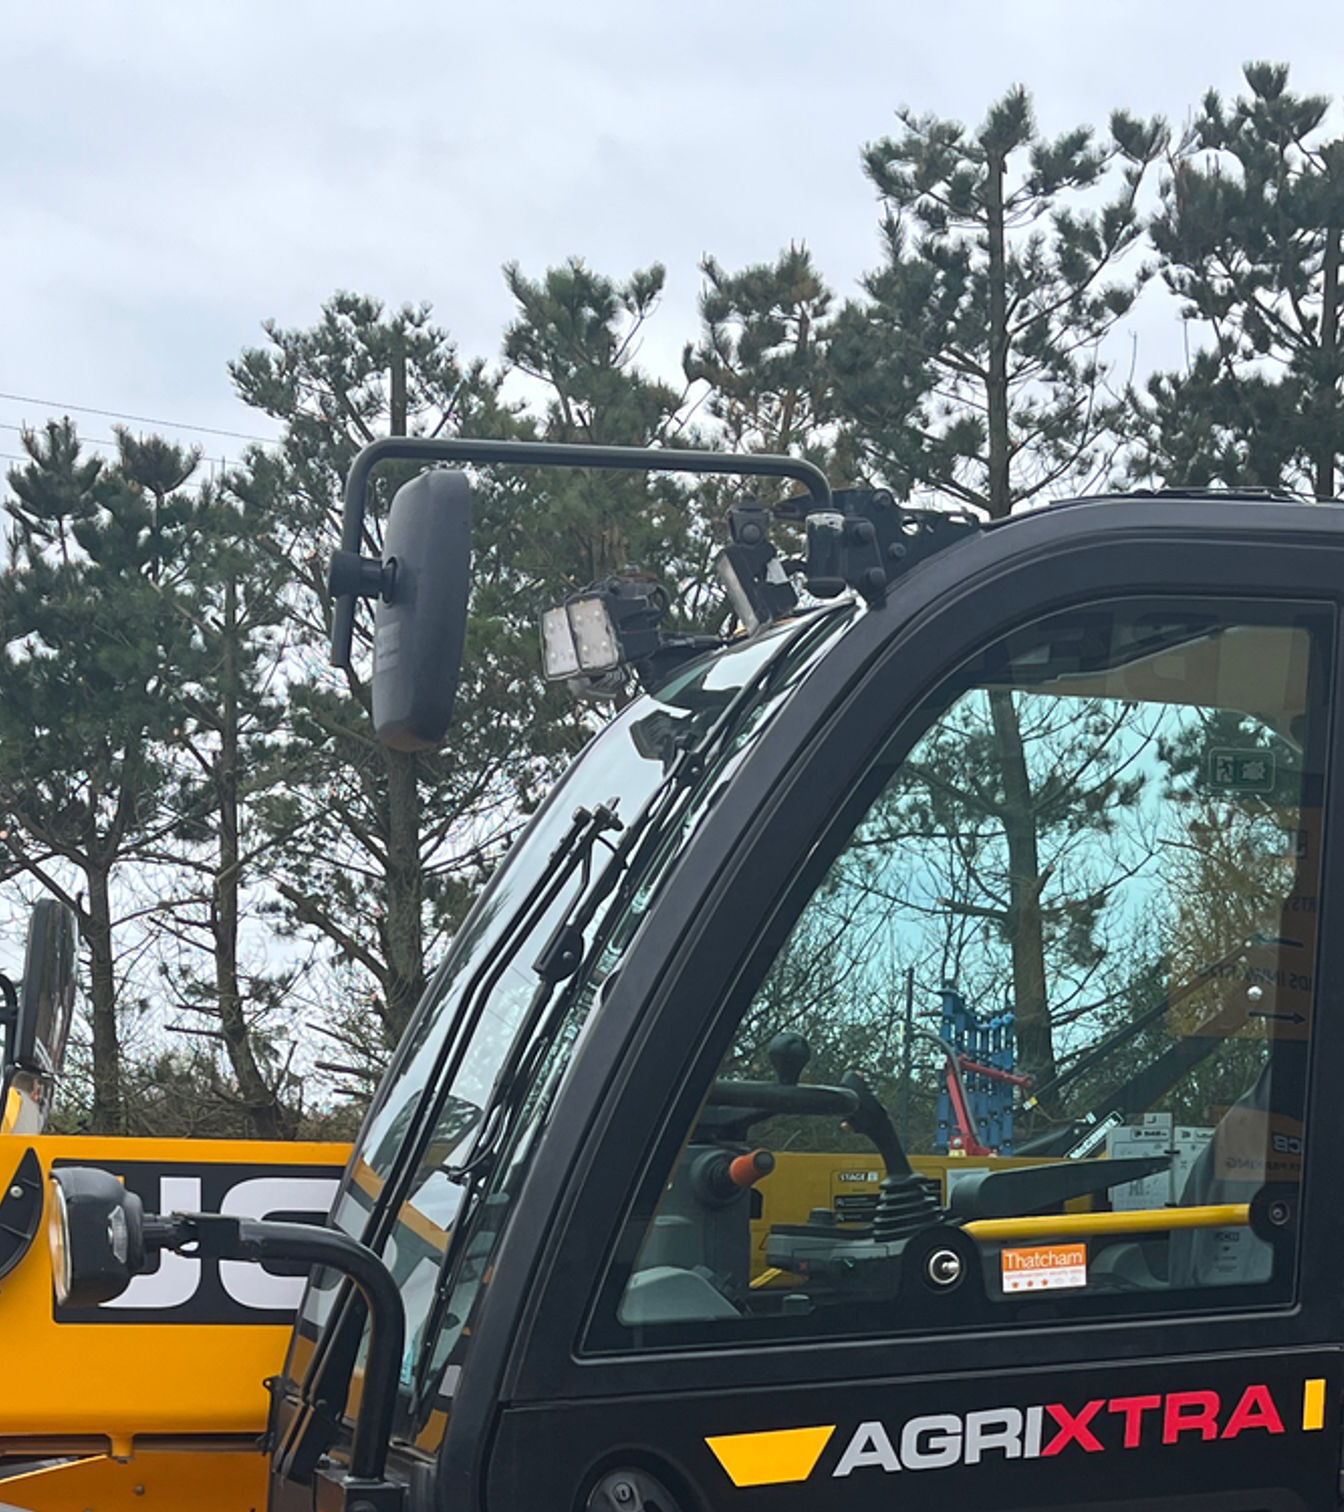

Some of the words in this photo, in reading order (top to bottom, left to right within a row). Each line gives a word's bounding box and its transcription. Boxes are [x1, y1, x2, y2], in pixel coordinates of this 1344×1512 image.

[99, 1177, 341, 1309] JC
[1005, 1250, 1083, 1270] Thatcham
[832, 1384, 1285, 1477] AGRIXTRA
